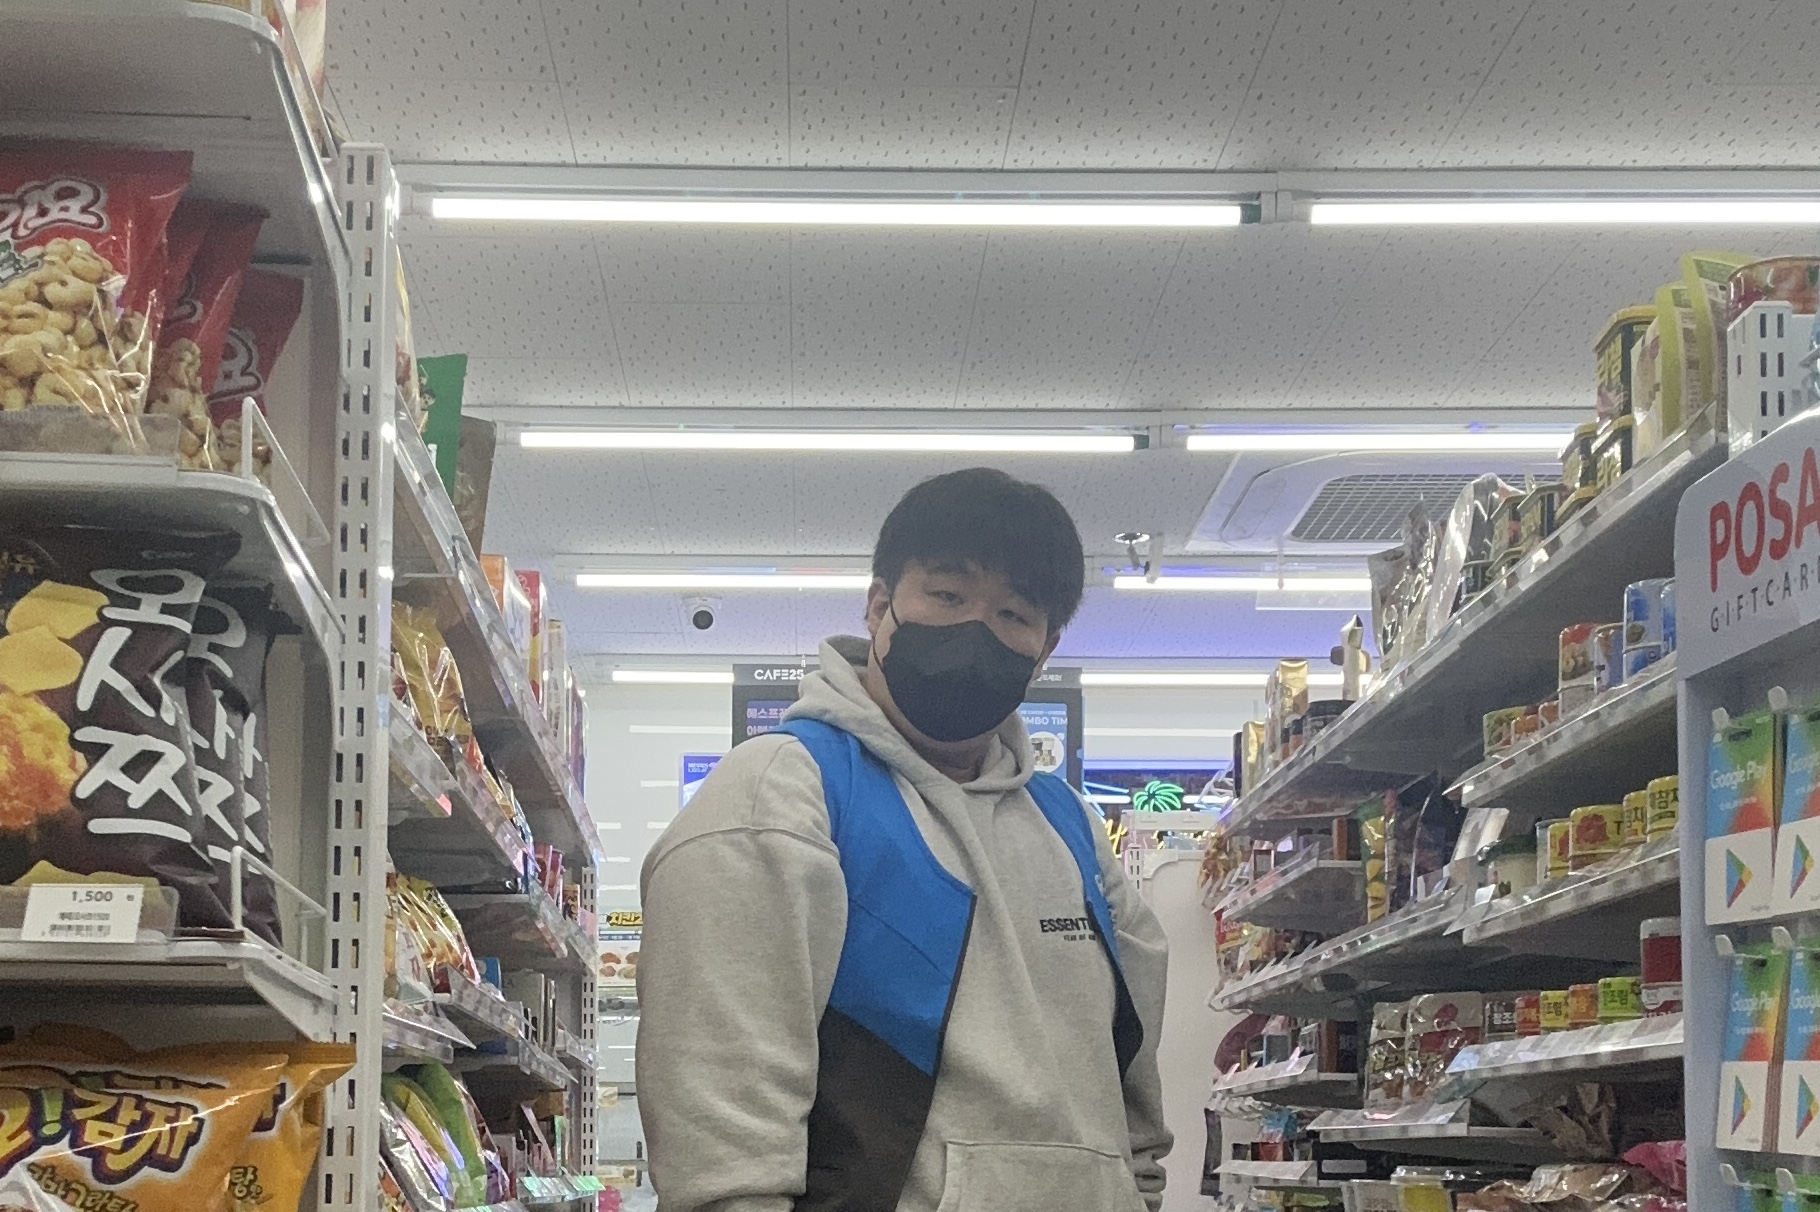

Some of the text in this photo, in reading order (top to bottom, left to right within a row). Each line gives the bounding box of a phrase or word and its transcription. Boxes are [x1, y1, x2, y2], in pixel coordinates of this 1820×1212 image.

[1709, 446, 1820, 593] POSA
[754, 668, 805, 681] CAFE25
[72, 890, 113, 903] 1,500
